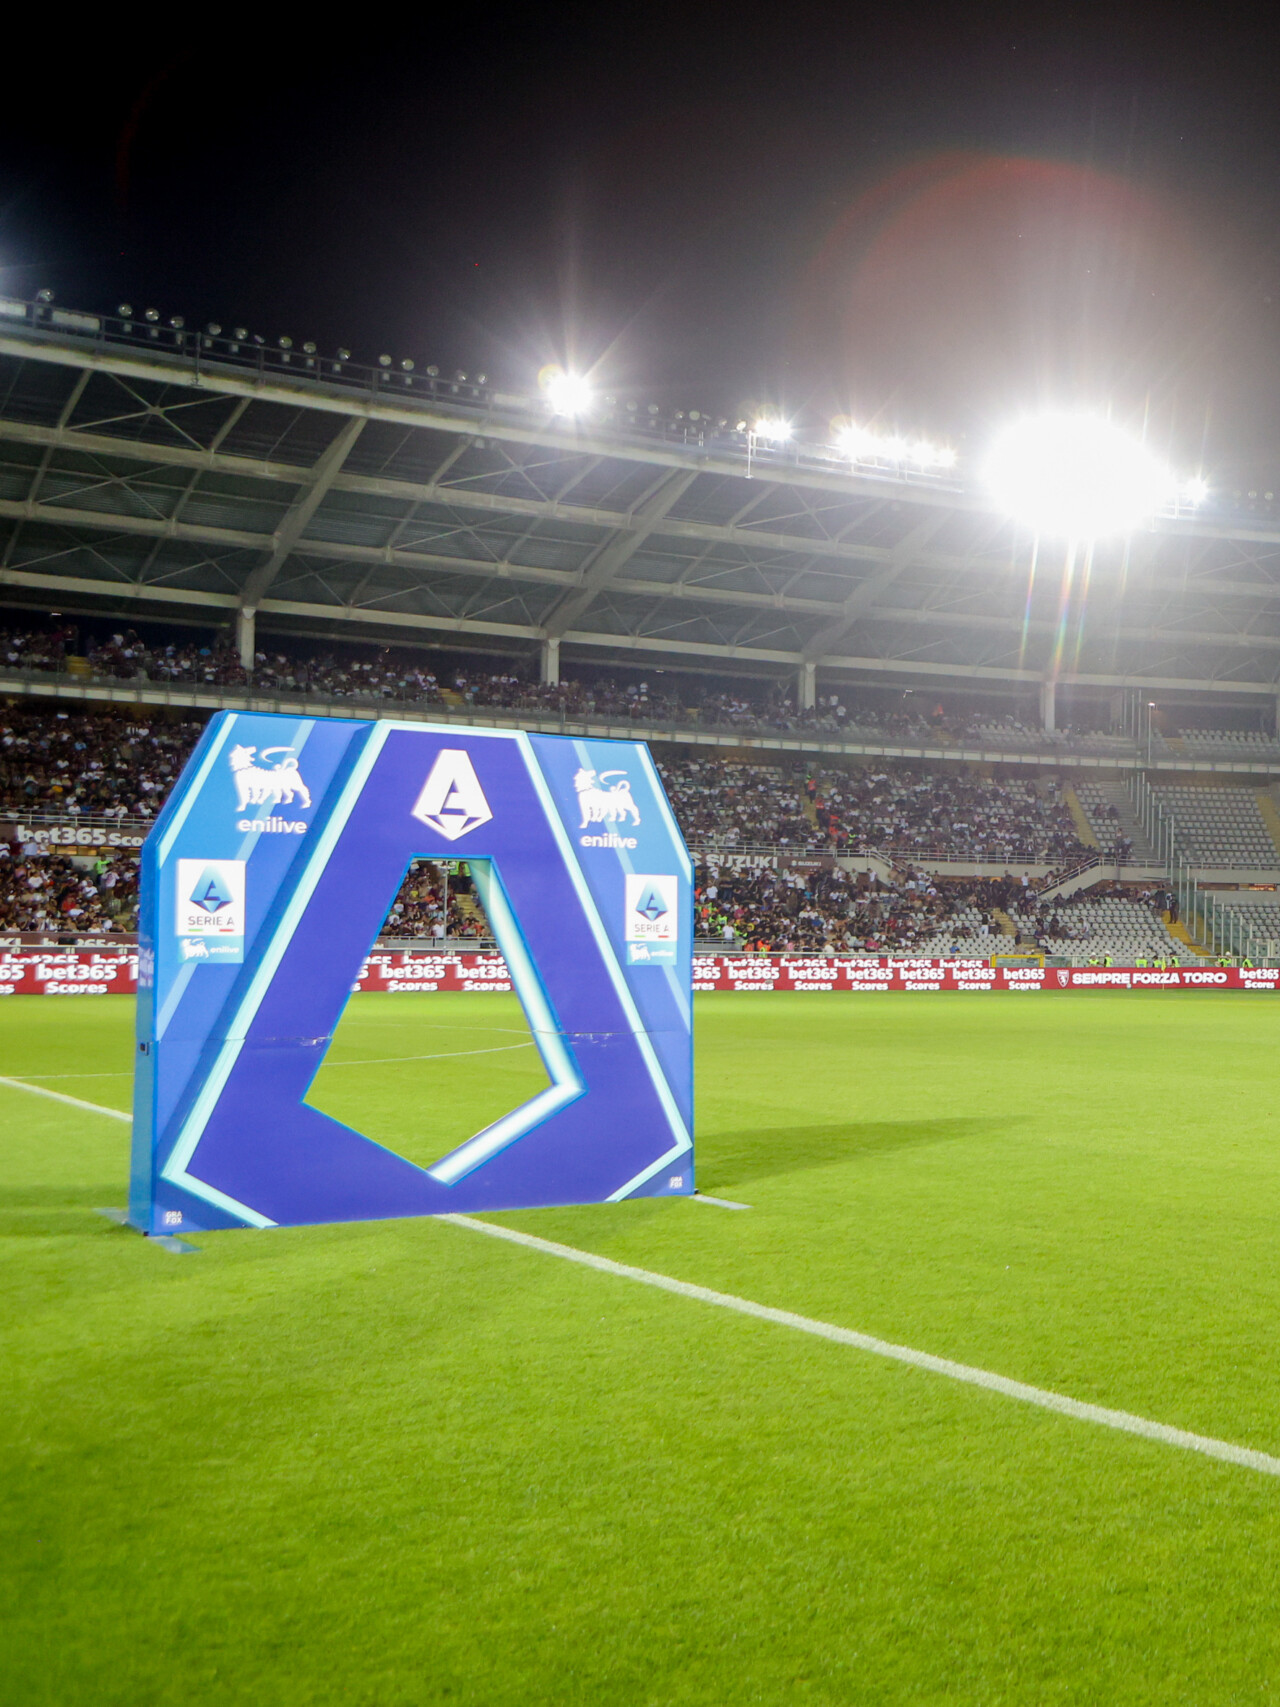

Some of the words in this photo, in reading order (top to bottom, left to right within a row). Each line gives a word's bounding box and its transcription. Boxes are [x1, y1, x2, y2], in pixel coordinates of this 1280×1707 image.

[238, 816, 308, 834] enilive
[17, 825, 107, 846] bet365
[108, 832, 146, 847] Sco
[580, 833, 638, 849] enilive
[706, 854, 778, 868] SUZUKI
[188, 916, 223, 926] SERIE
[226, 917, 235, 926] A
[634, 924, 660, 932] SERIE
[36, 965, 116, 980] bet365
[380, 965, 445, 978] bet365
[728, 966, 779, 981] bet365
[789, 967, 838, 979] bet365
[846, 967, 893, 980] bet365
[900, 967, 945, 980] bet365
[953, 967, 996, 979] bet365
[1003, 968, 1045, 980] bet365
[1240, 968, 1279, 981] bet365
[1072, 972, 1131, 984] SEMPRE
[1132, 972, 1180, 984] FORZA
[1182, 972, 1227, 983] TORO
[1245, 980, 1274, 988] Scores
[45, 982, 107, 994] Scores
[388, 980, 437, 993] Scores
[463, 980, 510, 991] Scores
[795, 981, 832, 990] Scores
[852, 981, 888, 990] Scores
[906, 981, 940, 990] Scores
[958, 981, 991, 990] Scores
[1009, 981, 1041, 990] Scores
[165, 1217, 182, 1225] FOX
